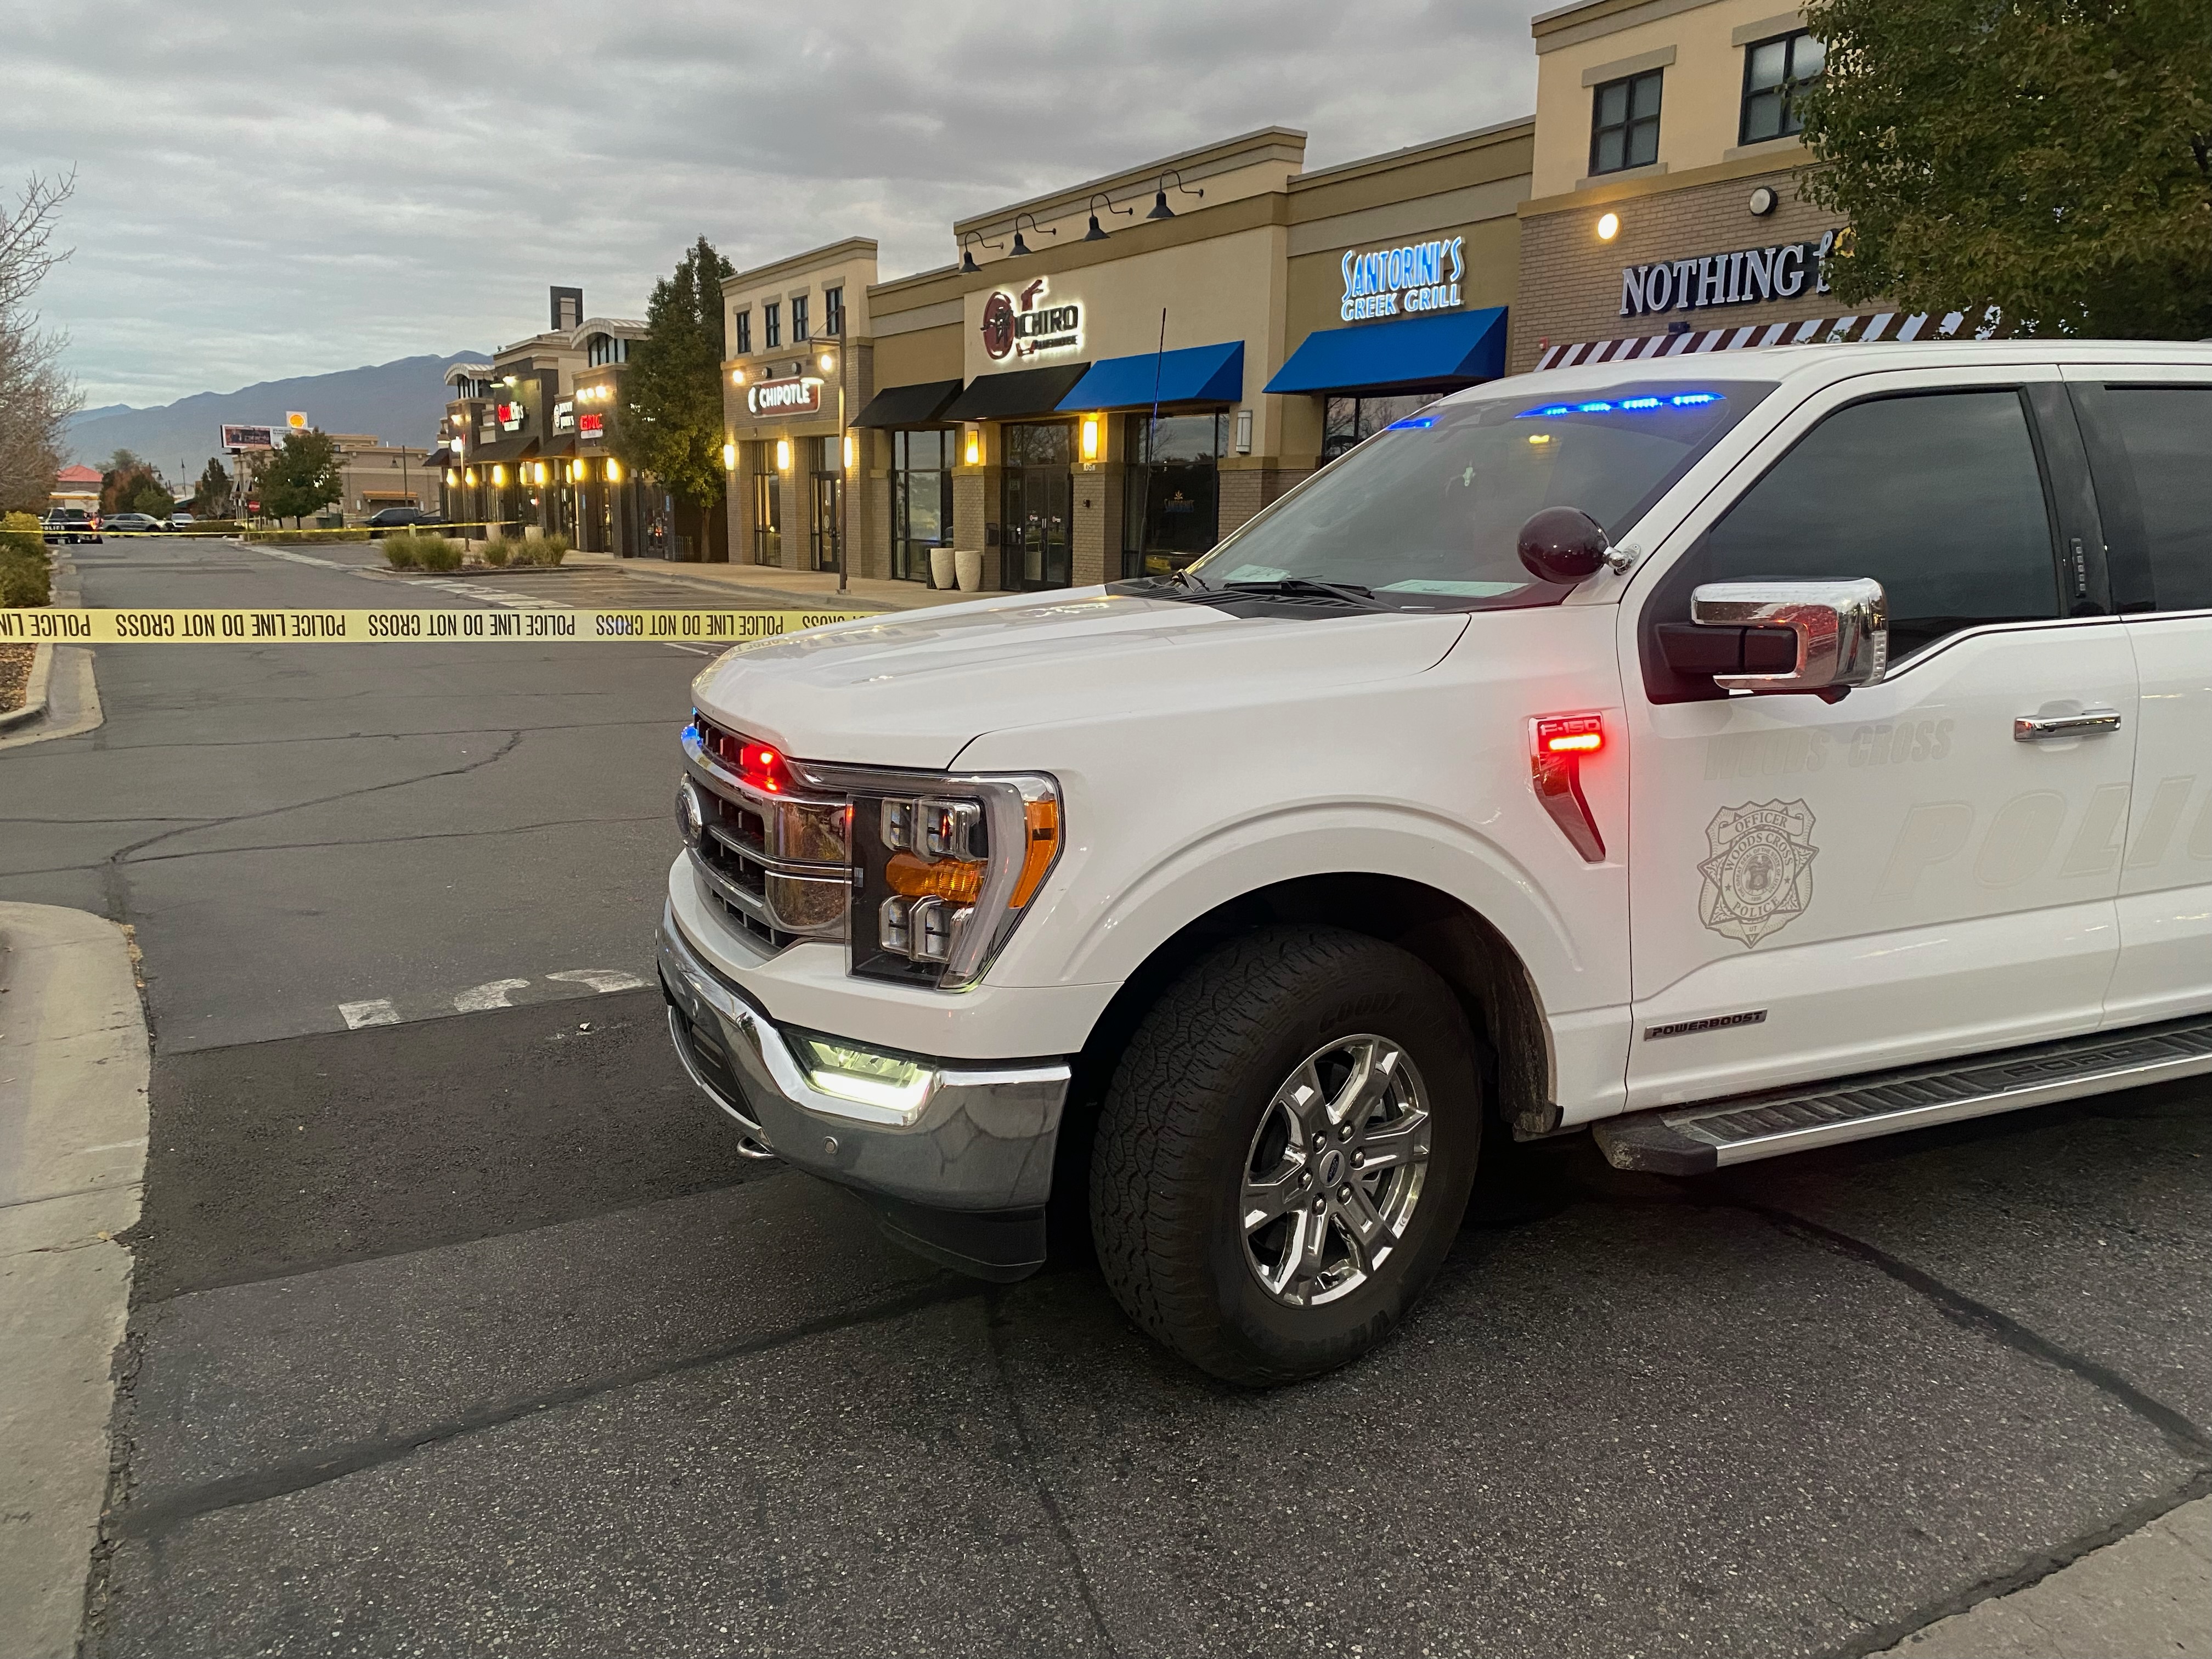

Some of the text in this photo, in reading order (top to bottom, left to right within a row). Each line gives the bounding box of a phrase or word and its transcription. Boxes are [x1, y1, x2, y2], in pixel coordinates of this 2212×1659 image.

[1341, 236, 1463, 302] SANTORINI'S
[1620, 245, 1804, 315] NOTHING
[1341, 283, 1461, 321] GREEK GRILL
[759, 383, 811, 408] CHIPOTLE
[580, 414, 602, 431] GNC
[28, 614, 91, 636] POLICE
[115, 614, 174, 637] CROSS
[182, 614, 215, 637] NOT
[222, 614, 244, 636] DO
[251, 614, 285, 636] LINE
[291, 614, 346, 636] POLICE
[368, 614, 420, 636] CROSS
[427, 614, 456, 636] NOT
[463, 614, 483, 636] DO
[489, 614, 521, 635] LINE
[525, 614, 575, 635] POLICE
[596, 614, 644, 636] CROSS
[649, 614, 676, 635] NOT
[682, 614, 700, 636] DO
[706, 614, 734, 635] LINE
[739, 616, 783, 636] POLICE
[1848, 719, 1955, 768] CROSS
[1735, 812, 1788, 833] OFFICER
[1725, 833, 1793, 871] WOODS CROSS
[1732, 896, 1780, 916] POLICE
[1652, 1011, 1763, 1037] POWERBOOST
